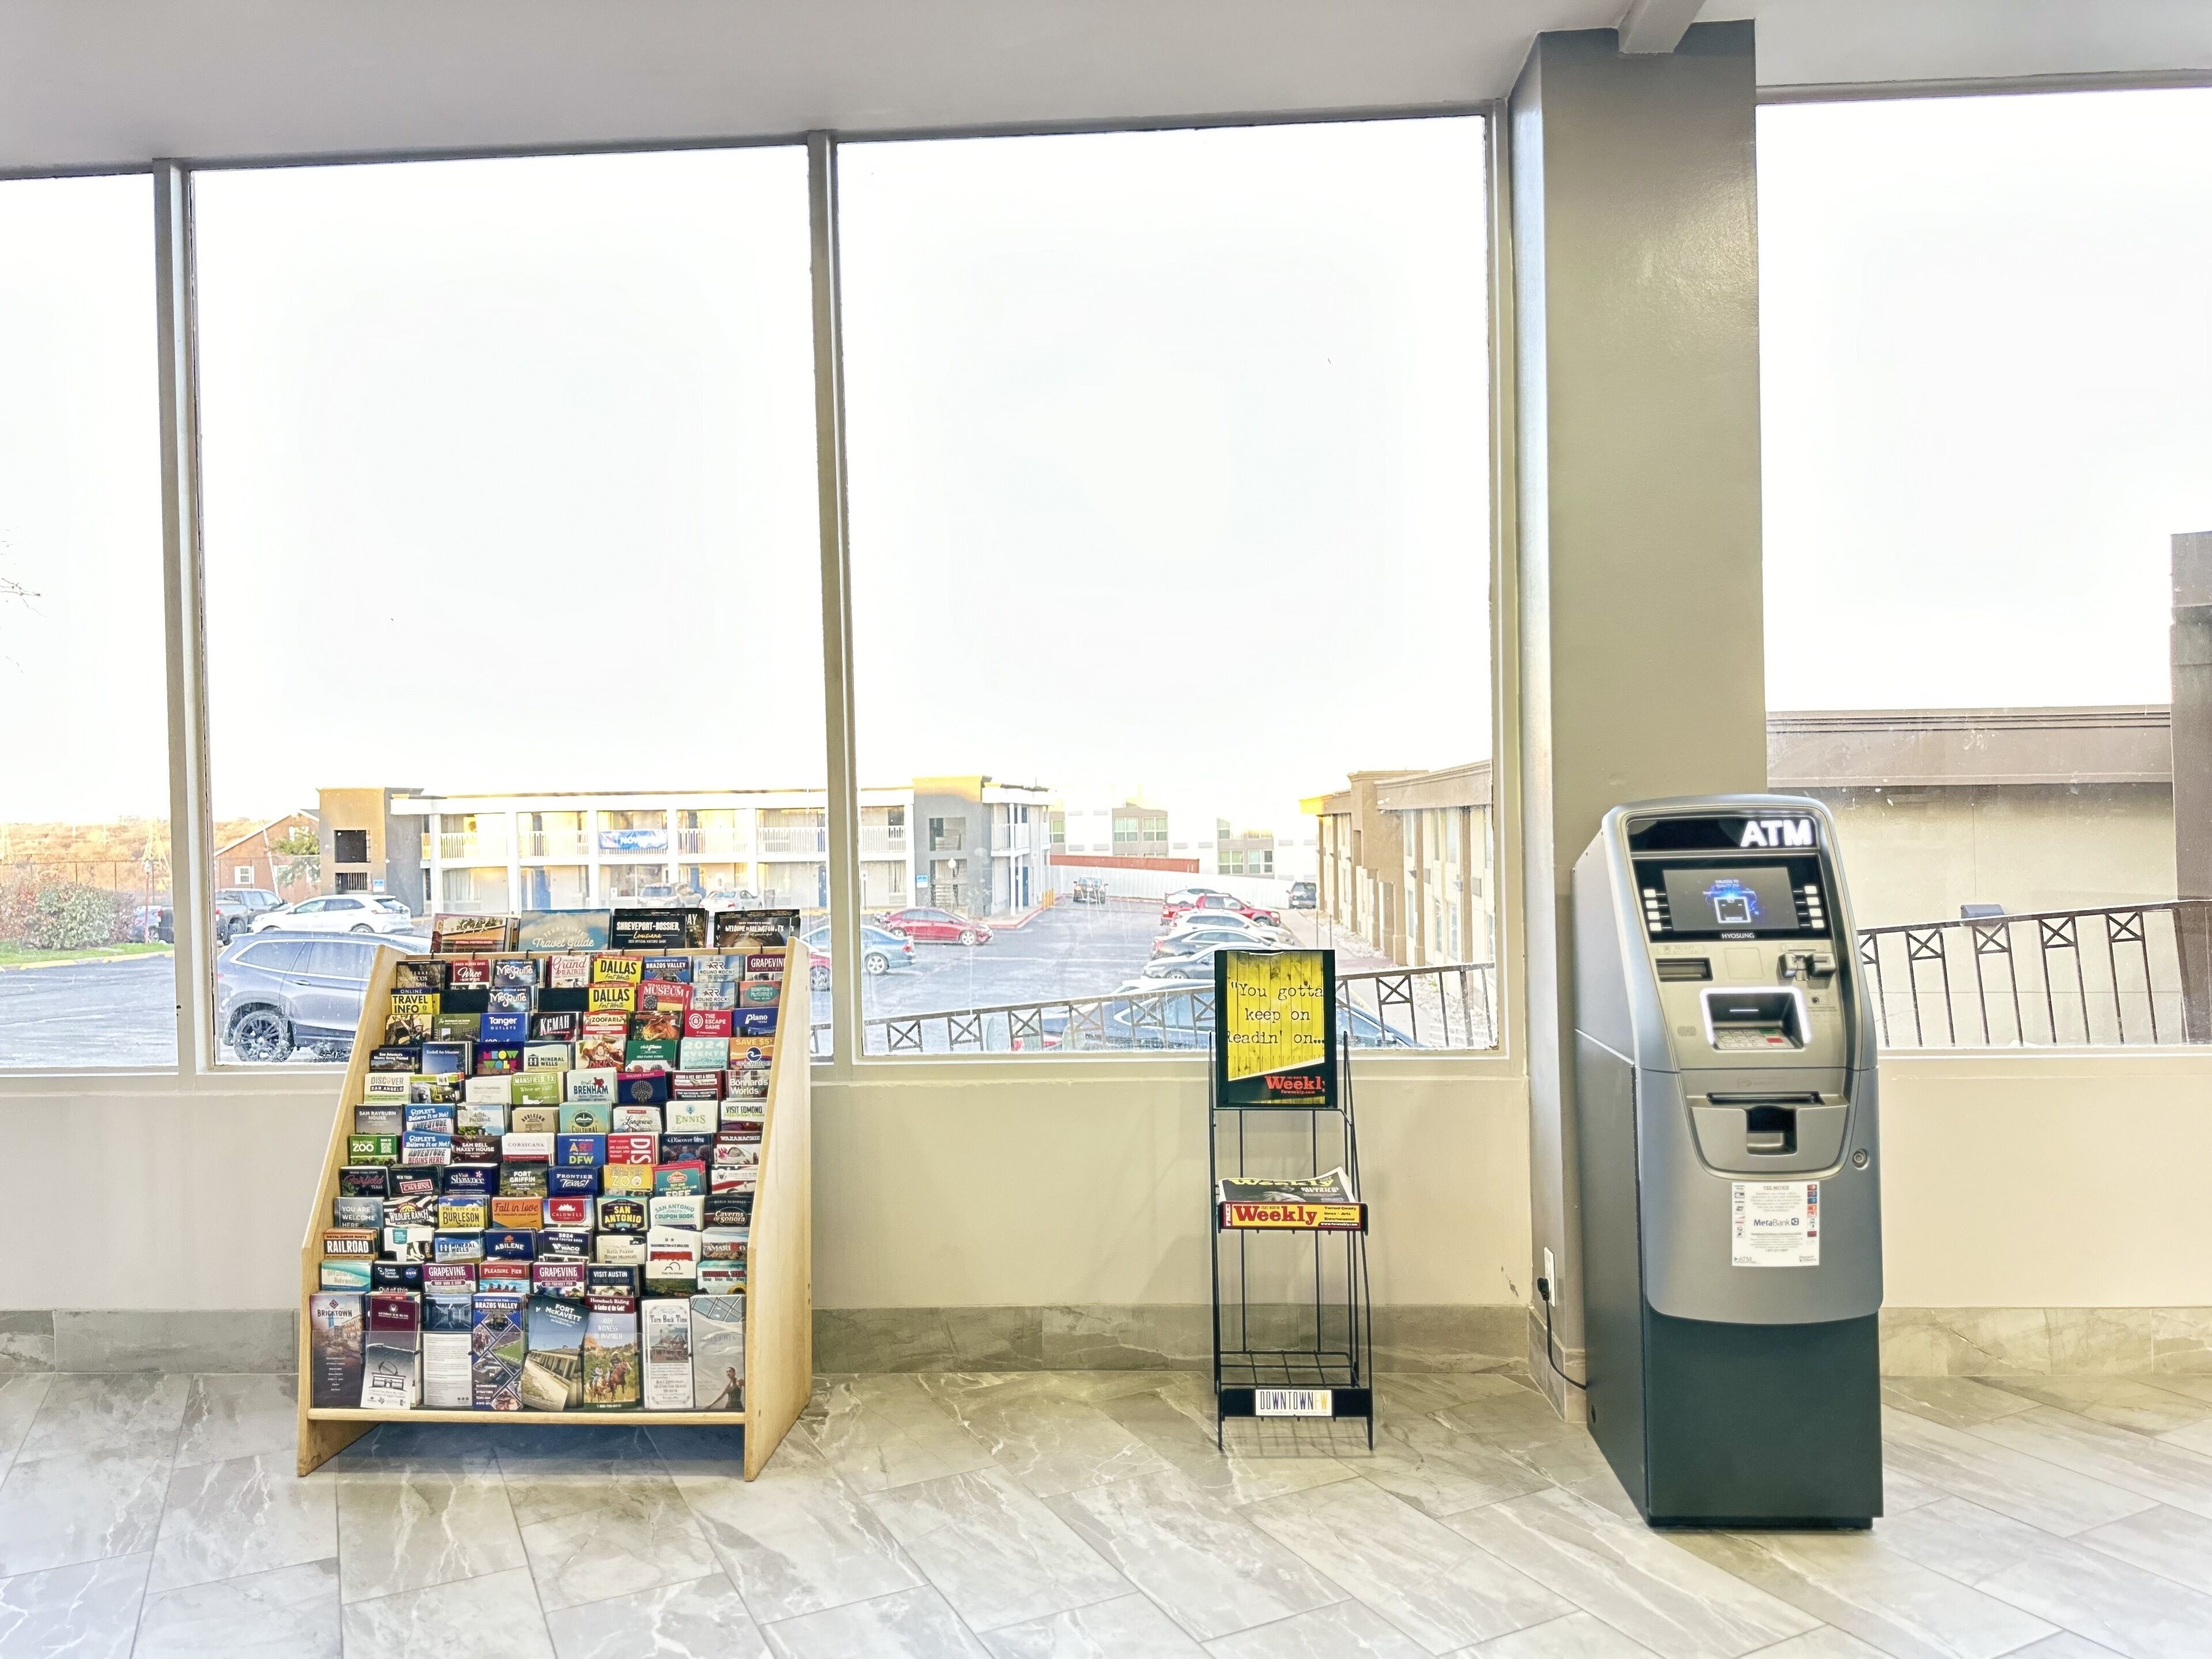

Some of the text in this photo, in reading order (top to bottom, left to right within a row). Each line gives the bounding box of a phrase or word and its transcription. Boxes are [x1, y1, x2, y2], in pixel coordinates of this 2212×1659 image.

[1740, 819, 1812, 847] ATM
[544, 925, 586, 937] TEXAS STATE
[634, 931, 662, 939] Louisiana
[532, 938, 595, 949] Travel Guide
[553, 956, 586, 971] Grand
[600, 960, 637, 975] DALLAS
[457, 967, 482, 978] Waco
[593, 988, 630, 1002] DALLAS
[643, 986, 684, 996] MUSEUM
[1231, 982, 1324, 1001] "You gotta
[392, 995, 428, 1004] TRAVEL
[394, 1005, 419, 1013] INFO
[745, 1014, 768, 1024] Plano
[1245, 1008, 1310, 1023] keep on
[489, 1017, 517, 1026] Tanger
[540, 1015, 570, 1036] KEMAH
[1293, 1033, 1325, 1044] on...
[684, 1040, 726, 1050] 2024
[483, 1050, 519, 1060] MEOW
[483, 1060, 517, 1070] WOLF
[729, 1078, 768, 1086] Bonnard's
[574, 1085, 609, 1094] BRENHAM
[411, 1108, 435, 1116] RIPLEY'S
[521, 1113, 546, 1122] BURLESON
[623, 1115, 653, 1126] Longview
[676, 1115, 706, 1124] ENNIS
[412, 1119, 447, 1130] ADVENTURE
[571, 1125, 598, 1134] CULTURAL
[409, 1135, 436, 1143] RIPLEY'S
[353, 1143, 374, 1152] ZOO
[569, 1142, 593, 1152] ART
[408, 1148, 446, 1157] ADVENTURE
[408, 1156, 445, 1164] BEGINS HERE!
[569, 1156, 594, 1165] DFW
[451, 1175, 485, 1184] Shawnee
[558, 1179, 589, 1188] Texas!
[1228, 1176, 1334, 1187] Weekly
[494, 1202, 539, 1212] Fall in love
[614, 1206, 631, 1214] SAN
[655, 1203, 695, 1213] SAN ANTONIO
[389, 1209, 429, 1223] WILDLIFE RANCH
[443, 1211, 479, 1225] BURLESON
[605, 1214, 642, 1224] ANTONIO
[1233, 1205, 1318, 1226] Weekly
[327, 1240, 369, 1253] RAILROAD
[495, 1243, 525, 1251] ABILENE
[429, 1267, 466, 1277] GRAPEVINE
[539, 1267, 578, 1277] GRAPEVINE
[317, 1309, 353, 1318] BRICKTOWN
[545, 1306, 582, 1322] McKAVETT
[555, 1304, 575, 1314] FORT
[650, 1315, 688, 1323] Turn Back Time
